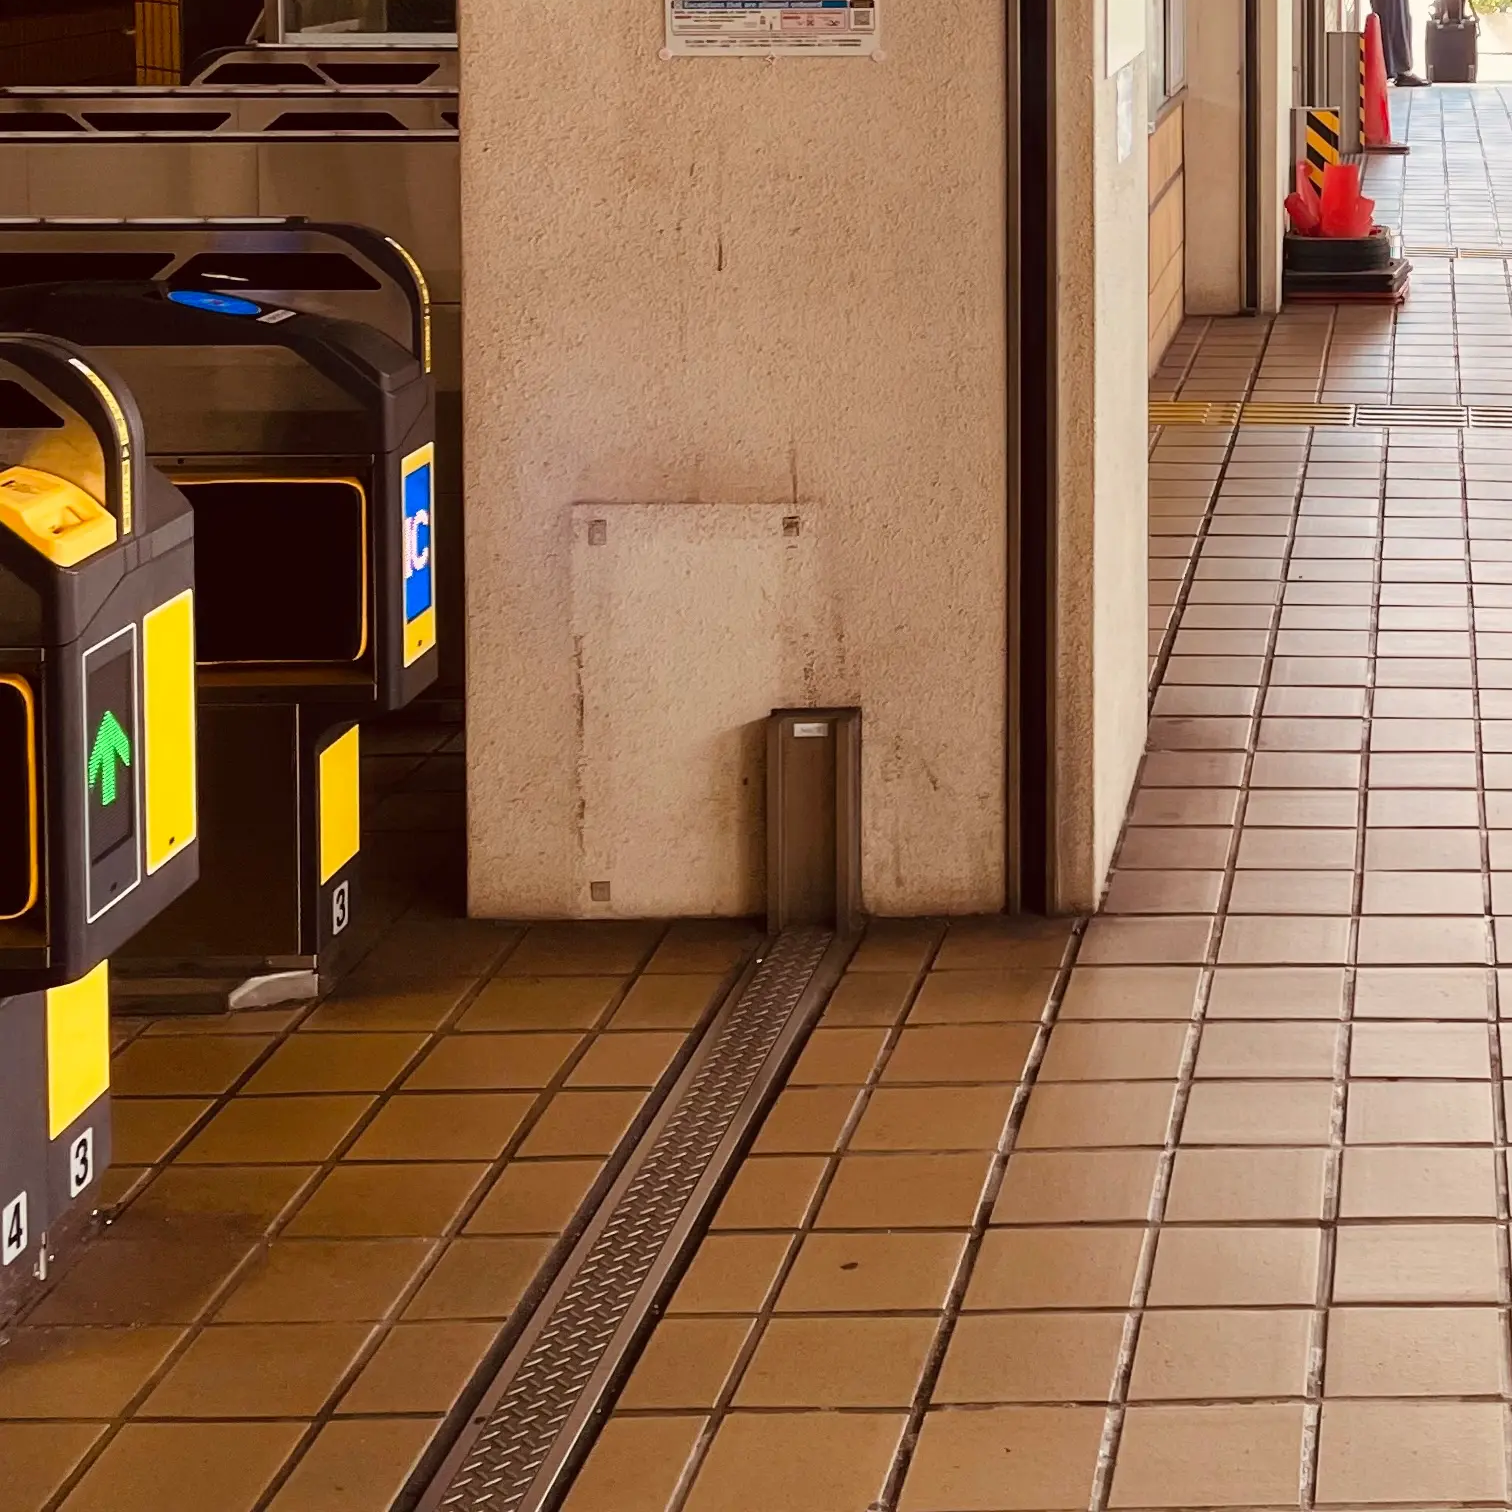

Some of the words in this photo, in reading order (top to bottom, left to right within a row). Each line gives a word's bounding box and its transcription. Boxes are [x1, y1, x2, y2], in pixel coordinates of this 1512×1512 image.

[404, 510, 429, 579] IC
[335, 887, 347, 929] 3
[75, 1138, 89, 1186] 3
[7, 1203, 23, 1251] 4
